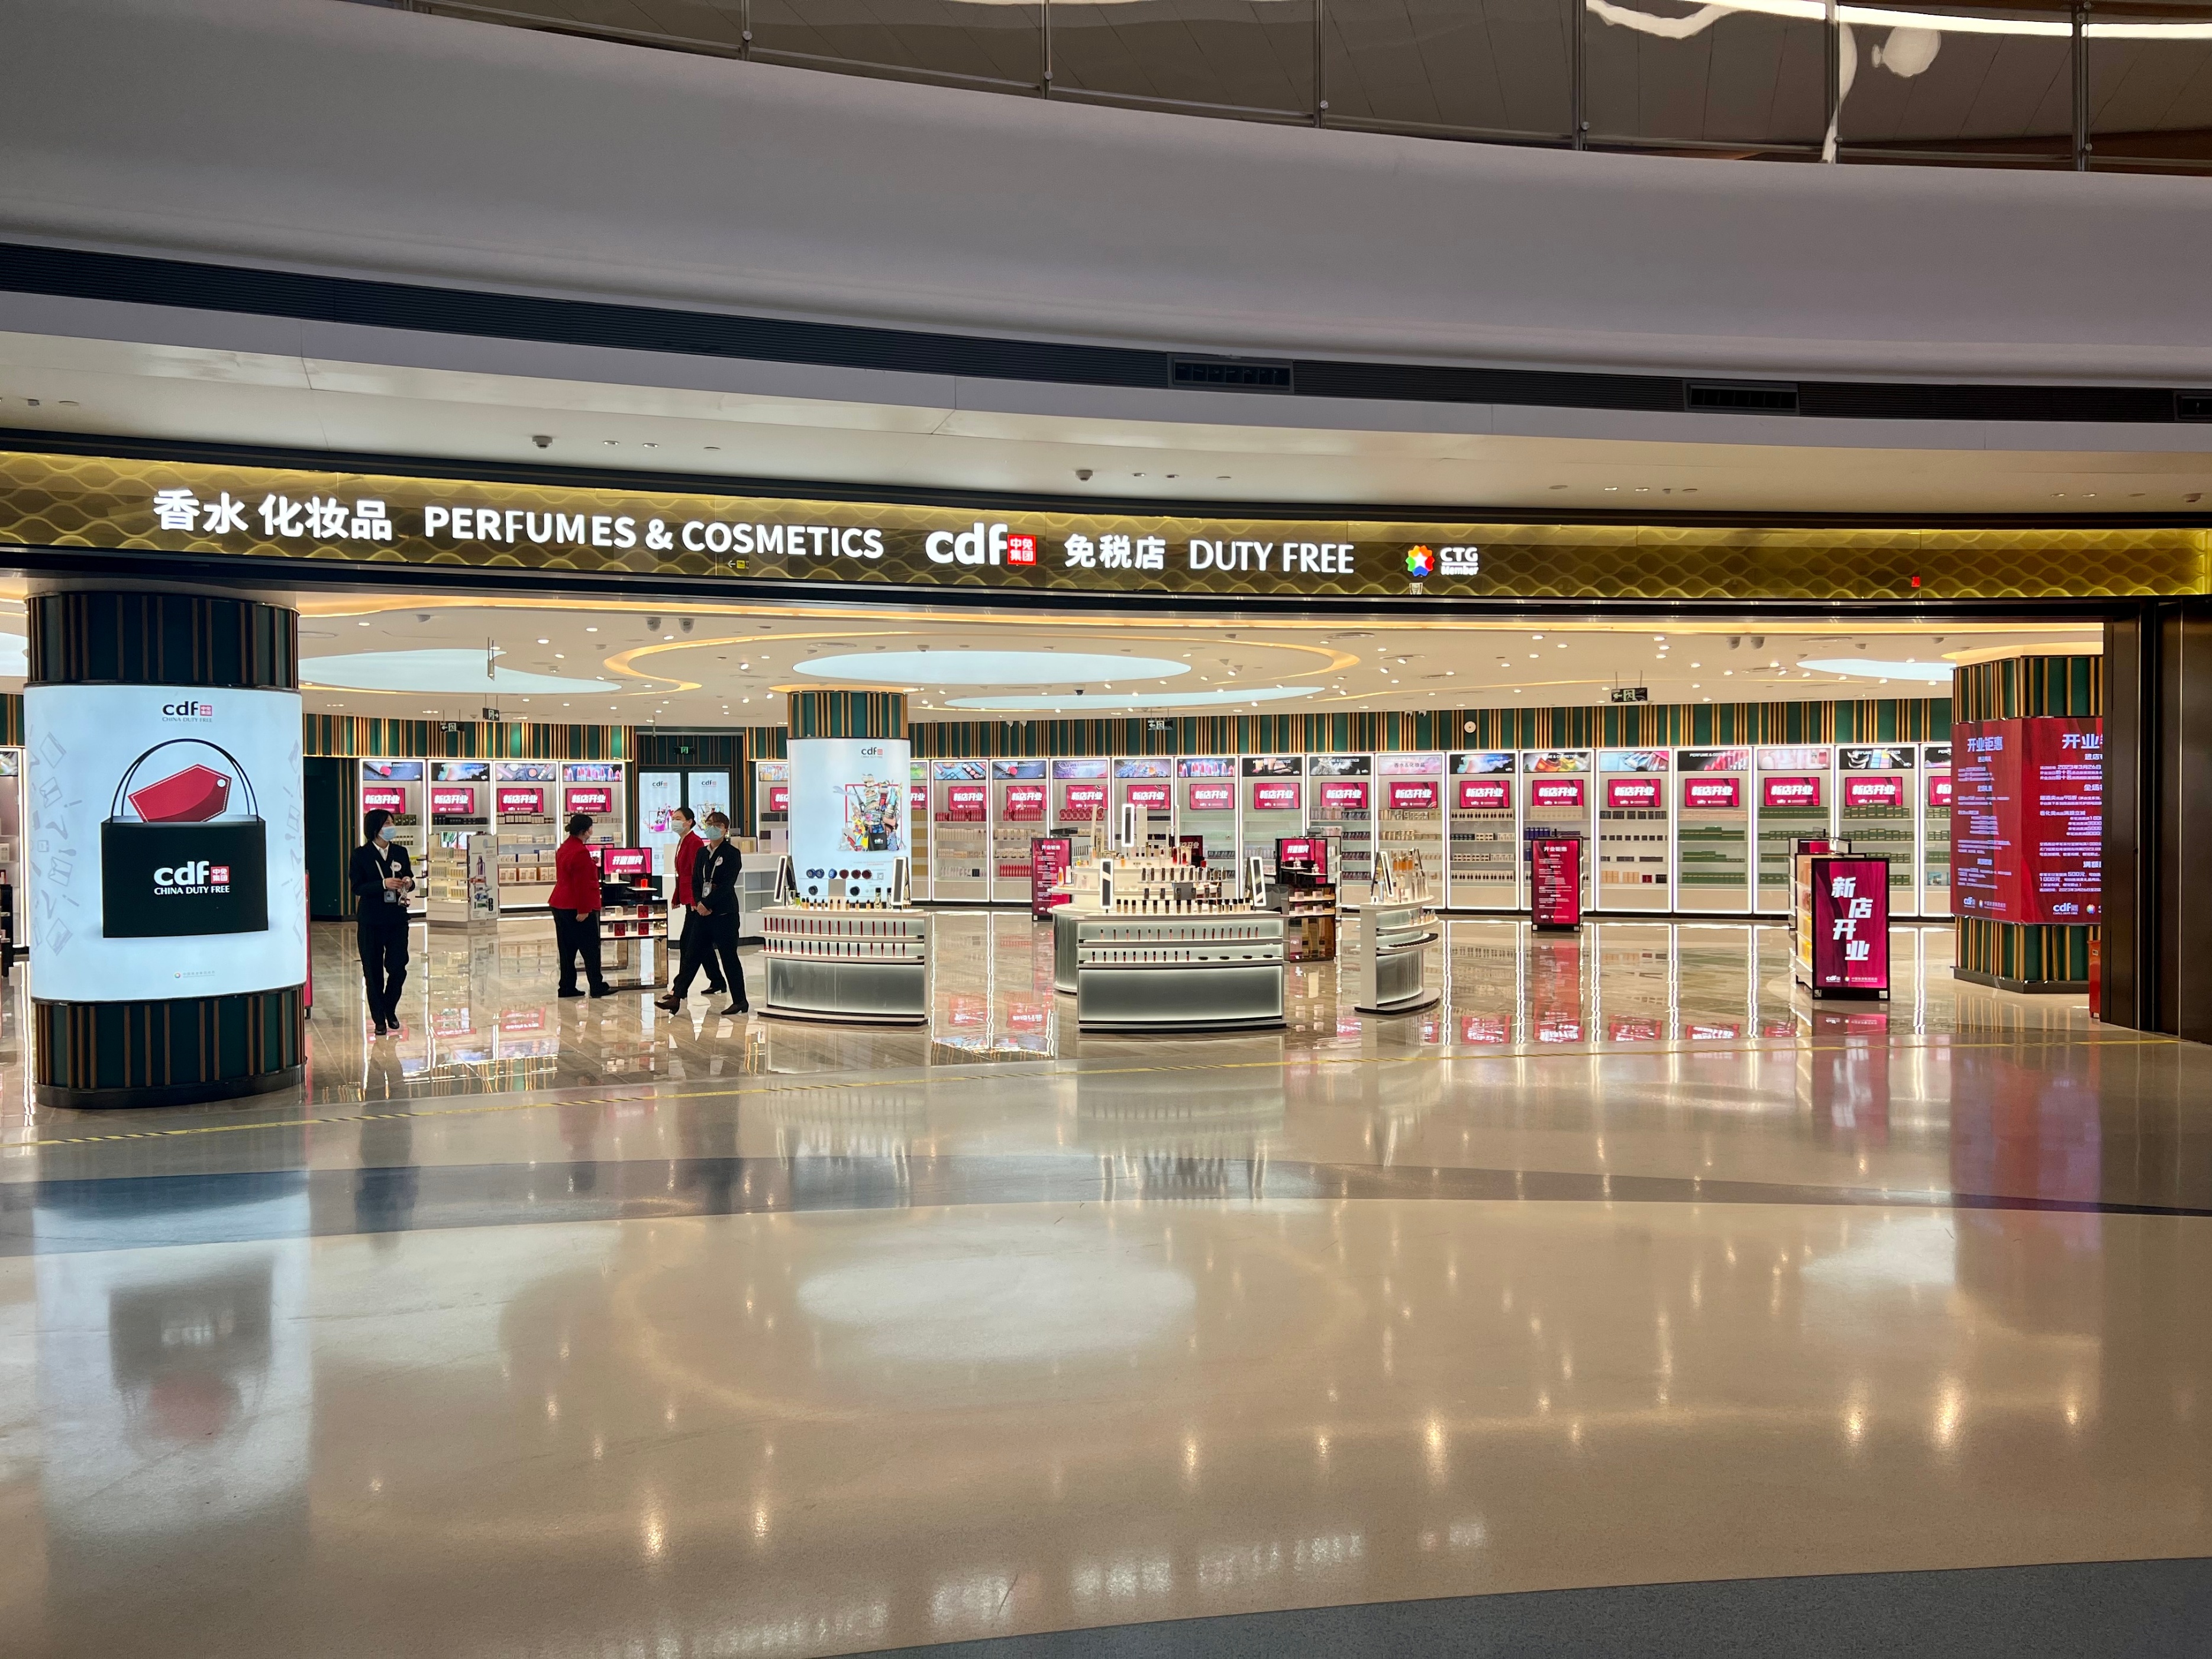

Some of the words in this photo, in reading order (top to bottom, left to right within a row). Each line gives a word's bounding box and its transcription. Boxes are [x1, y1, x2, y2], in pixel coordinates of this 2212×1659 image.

[425, 506, 637, 548] PERFUMES
[645, 518, 673, 550] &
[682, 521, 884, 559] COSMETICS
[925, 522, 1008, 565] cdf
[1064, 533, 1166, 570] 免税店
[1190, 540, 1273, 571] DUTY
[1283, 543, 1354, 573] FREE
[1440, 547, 1478, 562] CTG
[1441, 565, 1479, 575] Member
[163, 701, 198, 715] cdf
[154, 861, 209, 886] cdf
[154, 887, 183, 895] CHINA
[211, 885, 230, 893] FREE
[2052, 902, 2072, 912] cdf
